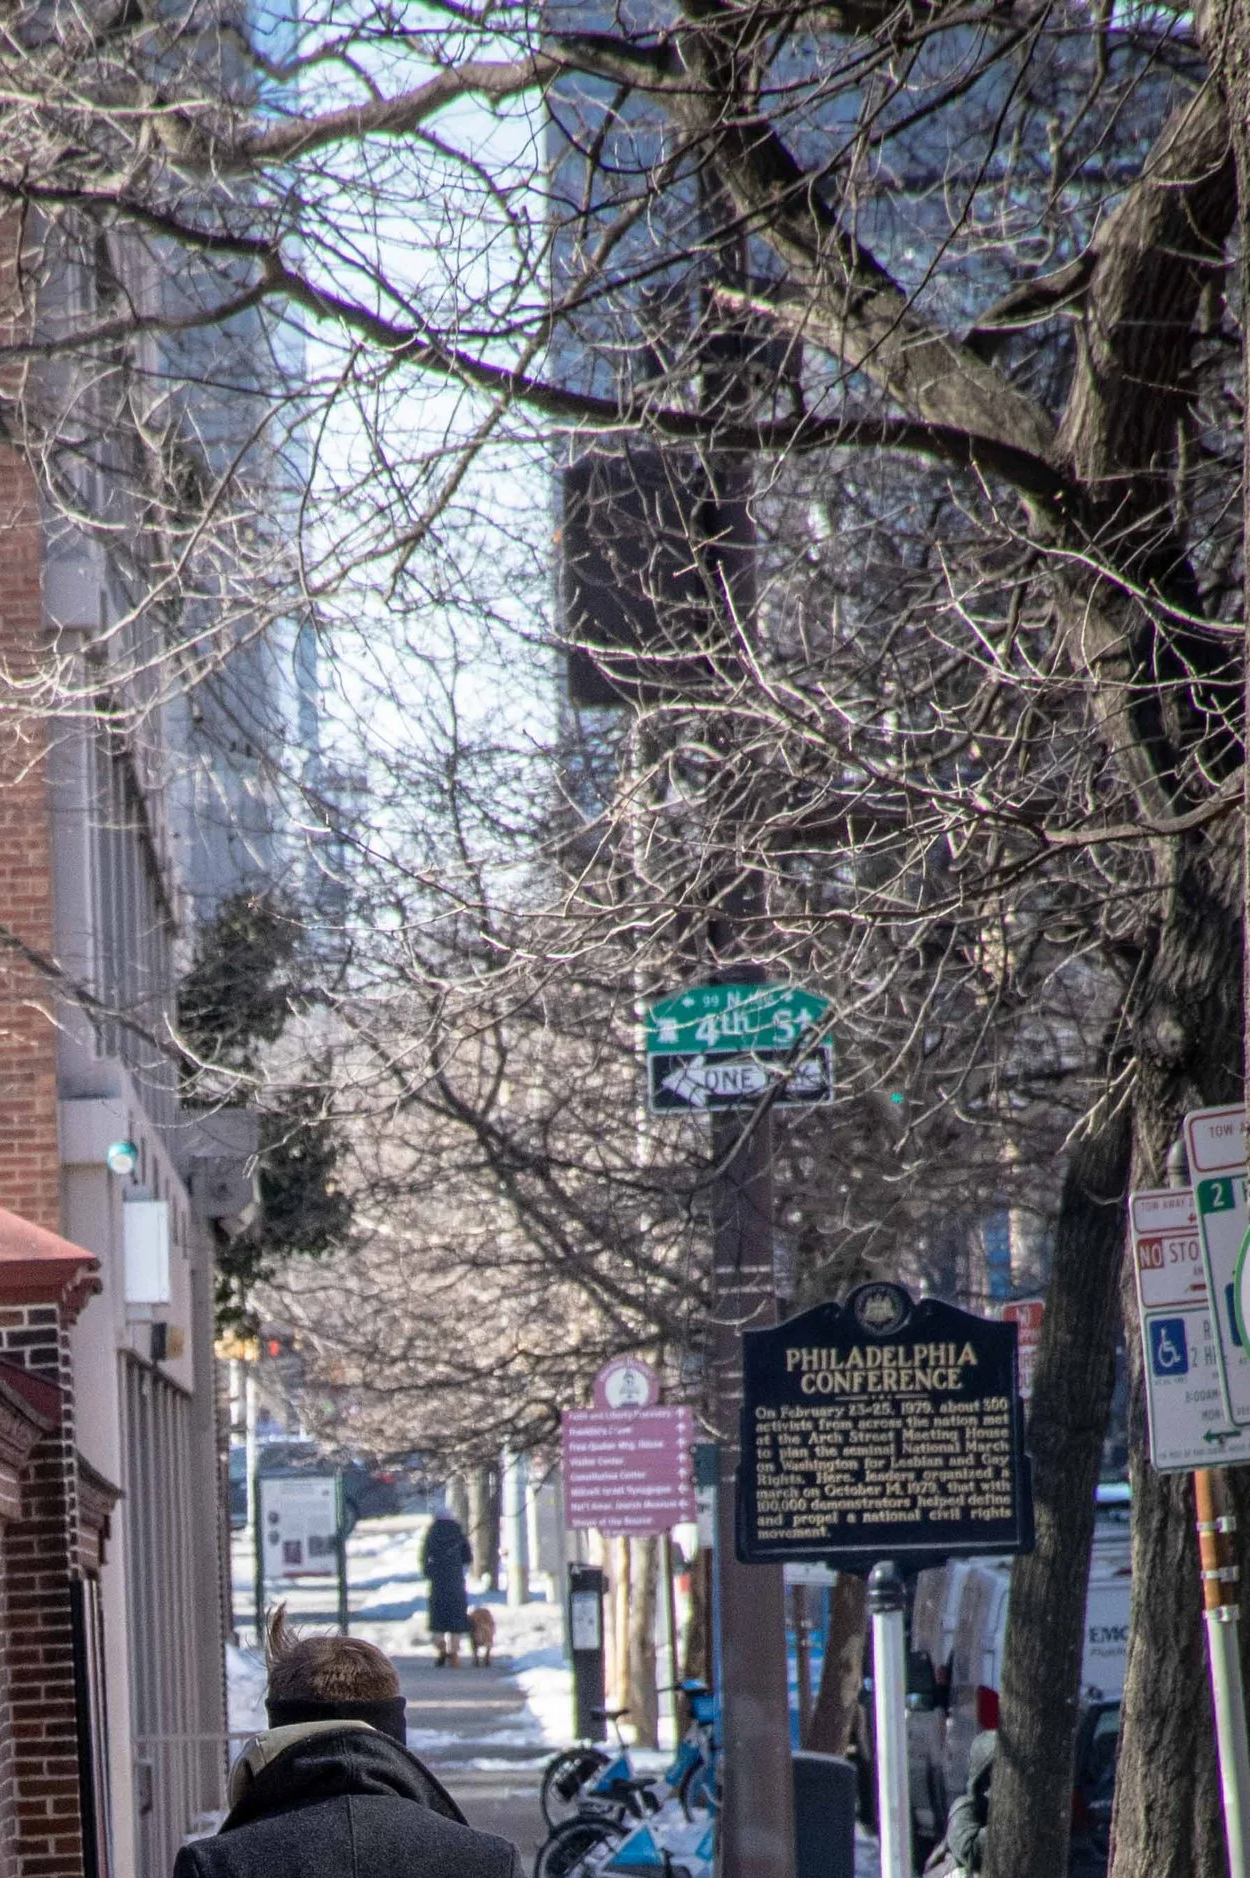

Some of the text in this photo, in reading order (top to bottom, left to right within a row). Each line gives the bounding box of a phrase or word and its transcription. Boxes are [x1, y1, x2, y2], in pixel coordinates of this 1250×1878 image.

[726, 990, 741, 1010] N
[695, 1008, 812, 1046] 4th St
[706, 1066, 754, 1091] ONE
[1207, 1124, 1233, 1138] TOW
[1210, 1183, 1225, 1207] 2
[1140, 1242, 1163, 1269] NO
[786, 1342, 978, 1372] PHILADELPHIA
[801, 1367, 964, 1394] CONFERENCE
[755, 1406, 777, 1420] On
[780, 1404, 845, 1420] February
[939, 1400, 980, 1414] about
[756, 1413, 1009, 1433] activists from across the nation met
[569, 1440, 587, 1452] Free
[638, 1438, 664, 1449] House
[756, 1427, 1009, 1446] at the Arch Street Meeting House
[757, 1440, 1010, 1461] to plan the seminal National March
[569, 1455, 624, 1467] Visitor Center
[756, 1453, 1010, 1473] on Washington for Lesbian and Gay
[570, 1470, 646, 1482] Constitution Center
[865, 1470, 914, 1483] leaders
[923, 1467, 993, 1482] organized
[1001, 1468, 1010, 1478] a
[626, 1485, 671, 1496] Synagogue
[756, 1486, 799, 1500] march
[803, 1486, 820, 1498] on
[824, 1483, 881, 1497] October
[947, 1481, 974, 1493] that
[980, 1479, 1011, 1493] with
[643, 1499, 677, 1509] Museum
[811, 1496, 910, 1511] demonstrators
[917, 1494, 964, 1509] helped
[968, 1493, 1011, 1506] define
[757, 1506, 1012, 1527] and propel a national civil rights
[757, 1526, 831, 1540] movement.
